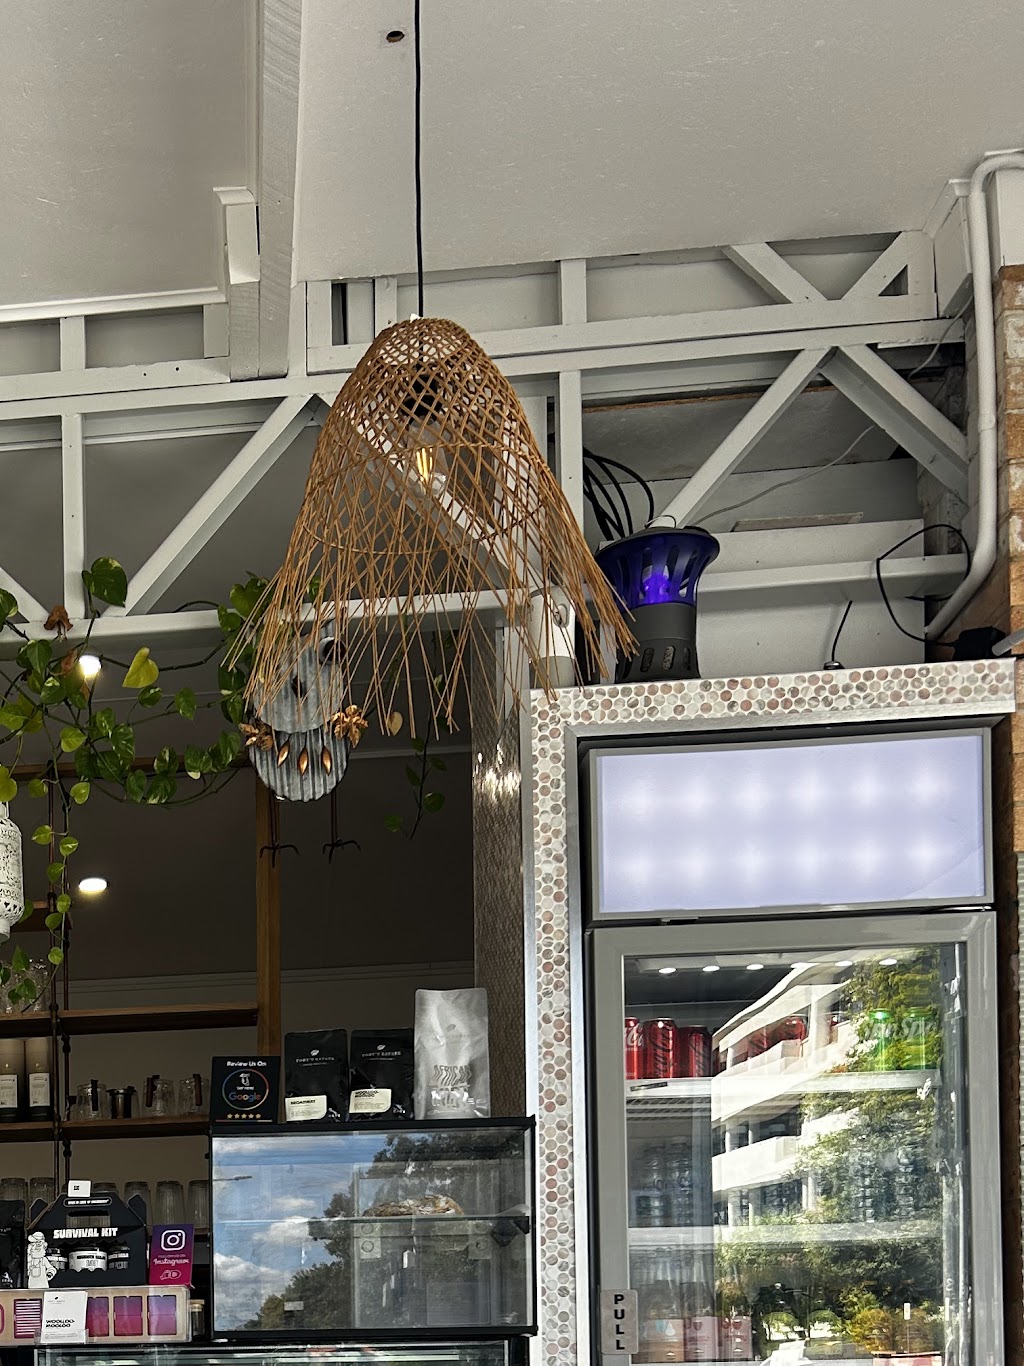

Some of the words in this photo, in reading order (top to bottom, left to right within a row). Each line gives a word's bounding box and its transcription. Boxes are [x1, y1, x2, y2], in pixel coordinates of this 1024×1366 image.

[228, 1091, 262, 1103] Google
[53, 1227, 99, 1239] SURVIVAL
[101, 1227, 119, 1237] KIT
[152, 1258, 190, 1266] Instagram
[613, 1293, 626, 1351] PULL
